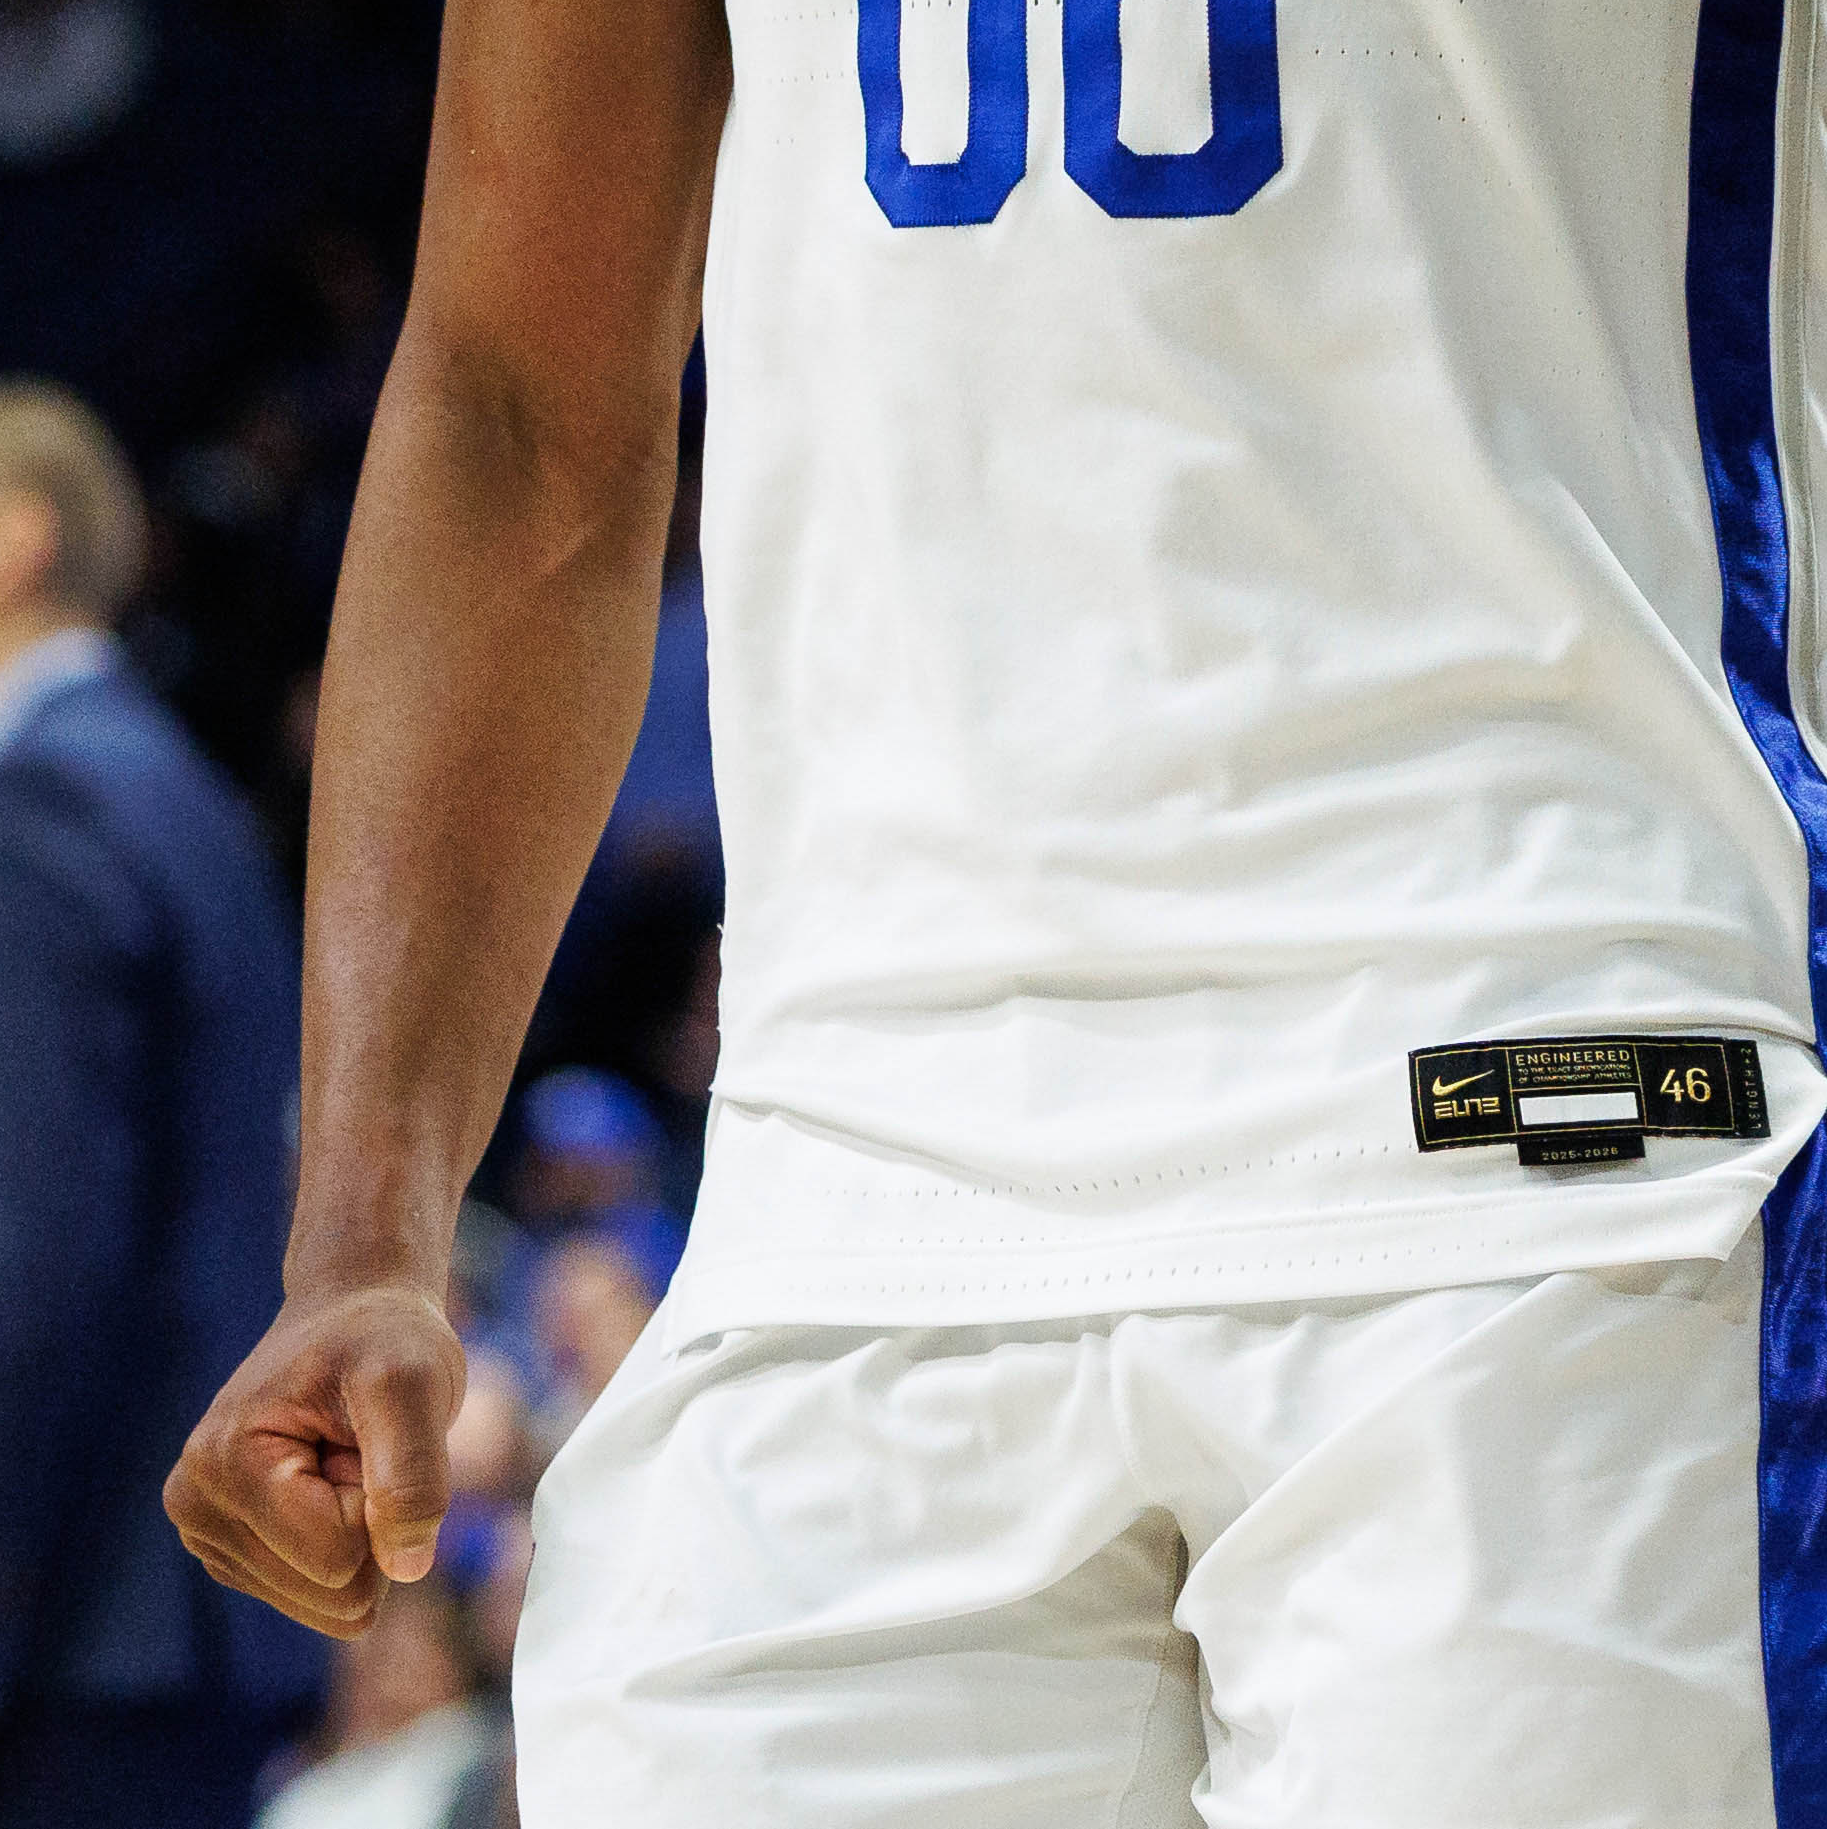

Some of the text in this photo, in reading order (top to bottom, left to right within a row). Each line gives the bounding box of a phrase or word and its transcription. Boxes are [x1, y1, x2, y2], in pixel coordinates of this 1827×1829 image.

[1515, 1050, 1631, 1066] ENGINEERED
[1660, 1068, 1711, 1103] 46
[1433, 1096, 1501, 1120] ELITE
[1542, 1146, 1619, 1161] 2025-2026
